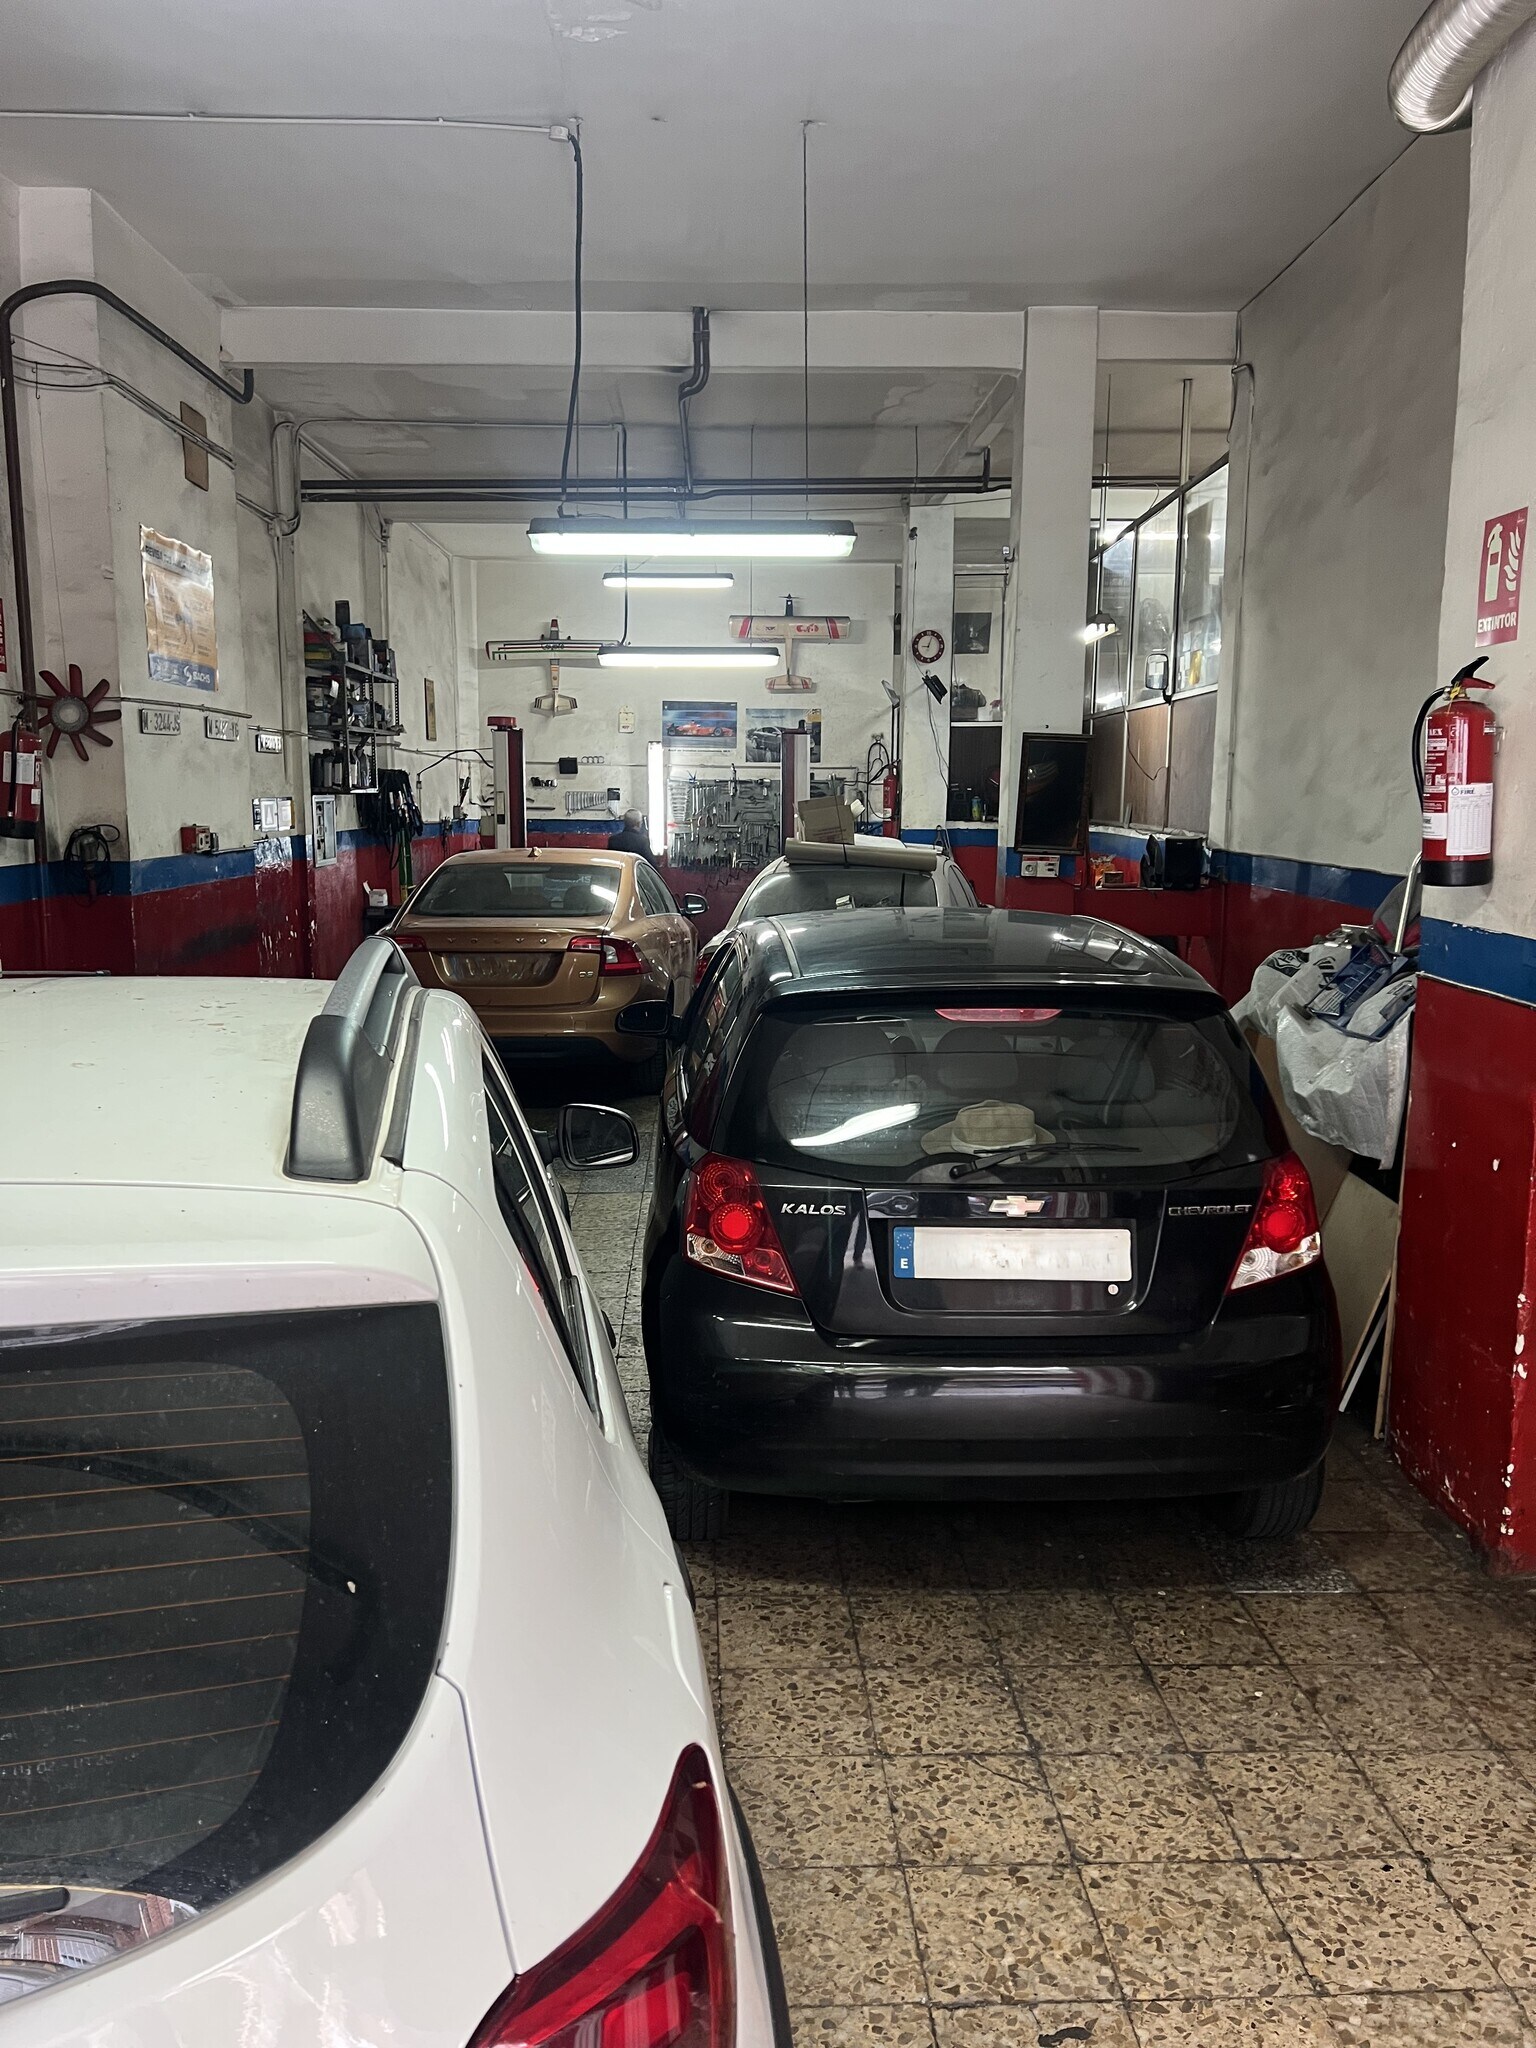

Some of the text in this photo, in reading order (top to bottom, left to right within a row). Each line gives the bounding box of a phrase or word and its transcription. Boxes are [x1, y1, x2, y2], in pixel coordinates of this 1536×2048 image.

[1477, 611, 1517, 634] EXTINTOR
[192, 671, 211, 684] SACHS
[446, 936, 548, 945] VOVO
[780, 1202, 847, 1217] KALOS
[1168, 1204, 1253, 1216] CHEVROLET
[900, 1258, 909, 1270] E
